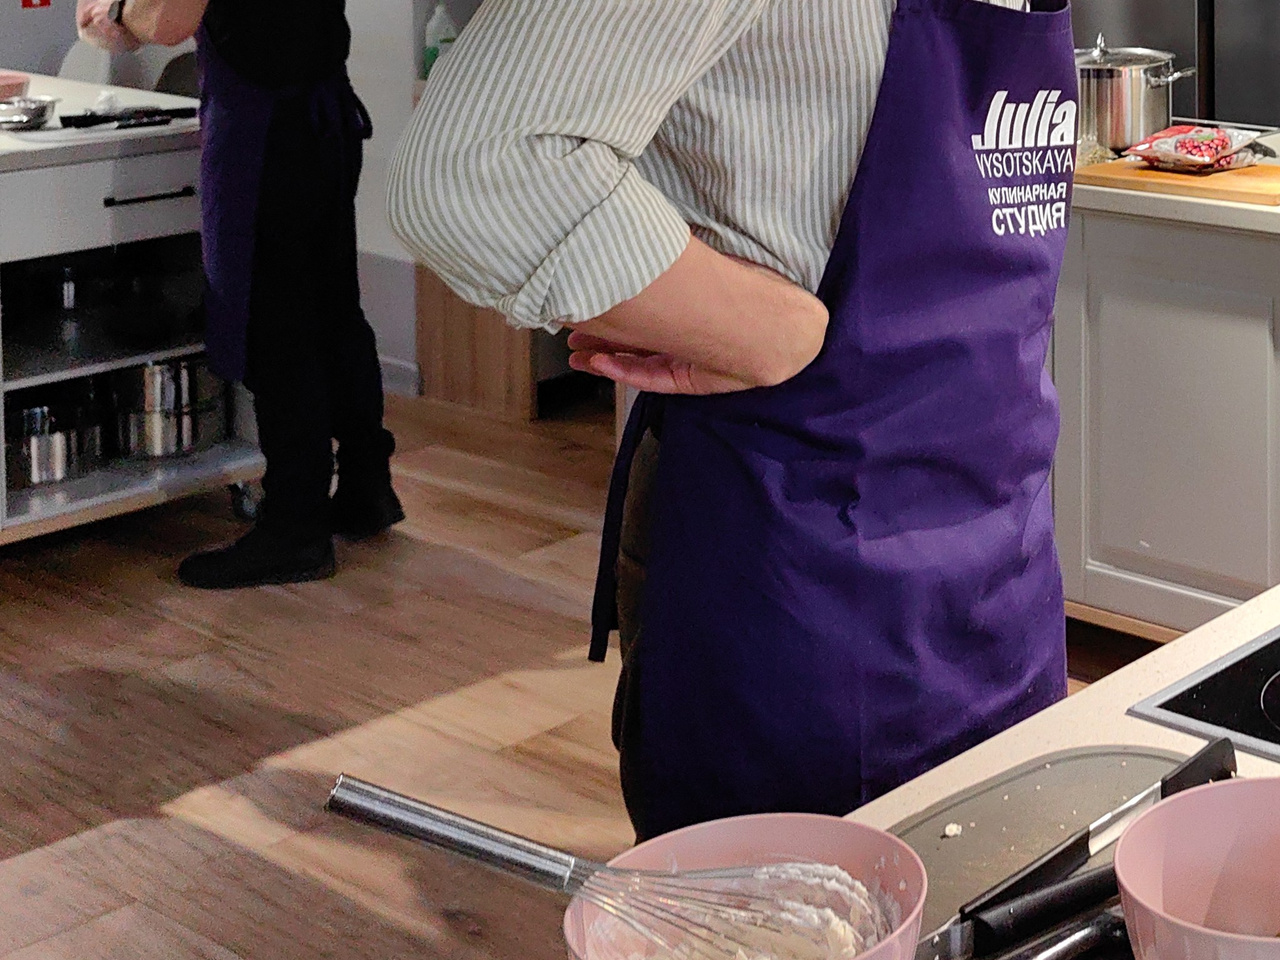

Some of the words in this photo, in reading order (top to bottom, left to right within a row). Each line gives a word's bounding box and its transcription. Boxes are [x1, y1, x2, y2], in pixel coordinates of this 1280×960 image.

[971, 90, 1077, 150] Julia
[975, 148, 1074, 178] VYSOTSKAYA
[988, 182, 1067, 205] КУЛИНАРНАЯ
[992, 201, 1066, 238] СТУДИЯ
